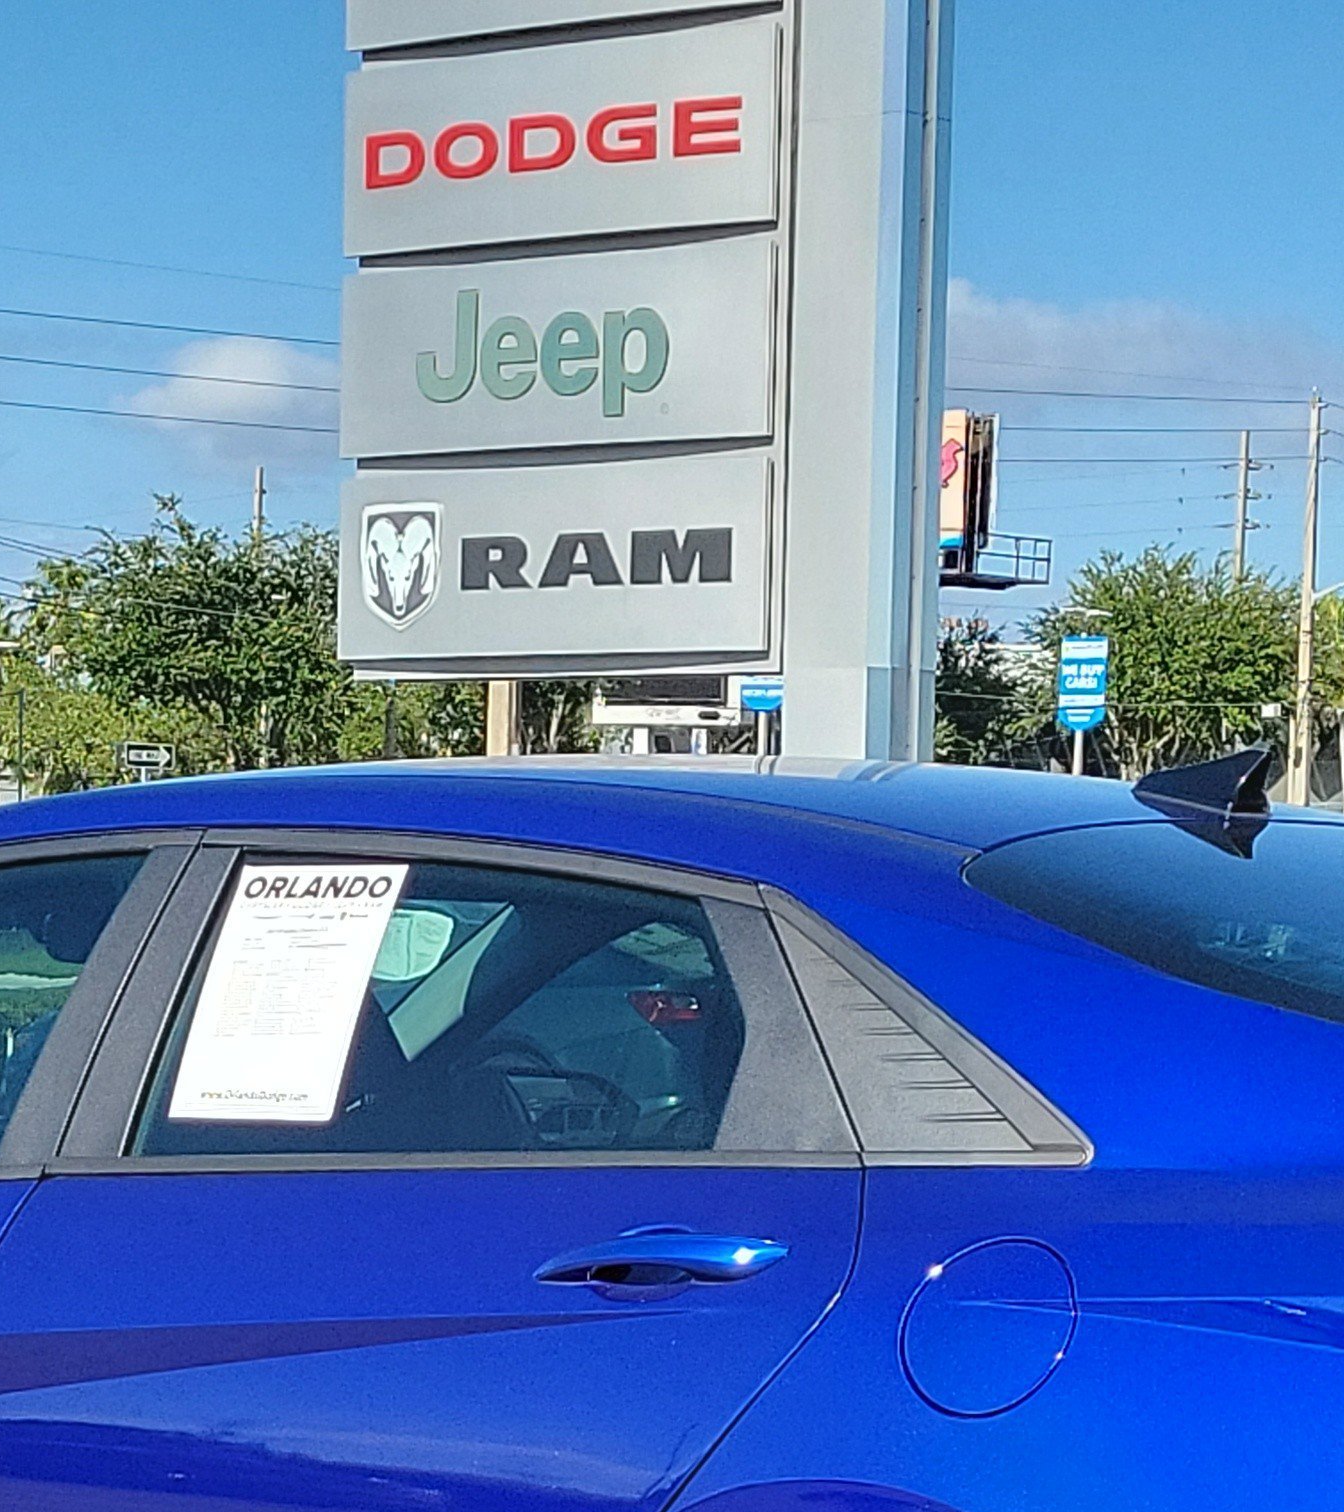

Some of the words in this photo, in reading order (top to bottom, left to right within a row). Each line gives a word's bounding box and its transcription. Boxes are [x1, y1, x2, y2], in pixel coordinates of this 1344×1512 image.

[365, 95, 744, 191] DODGE
[416, 288, 670, 418] Jeep
[460, 526, 733, 591] RAM
[244, 876, 393, 899] ORLANDO
